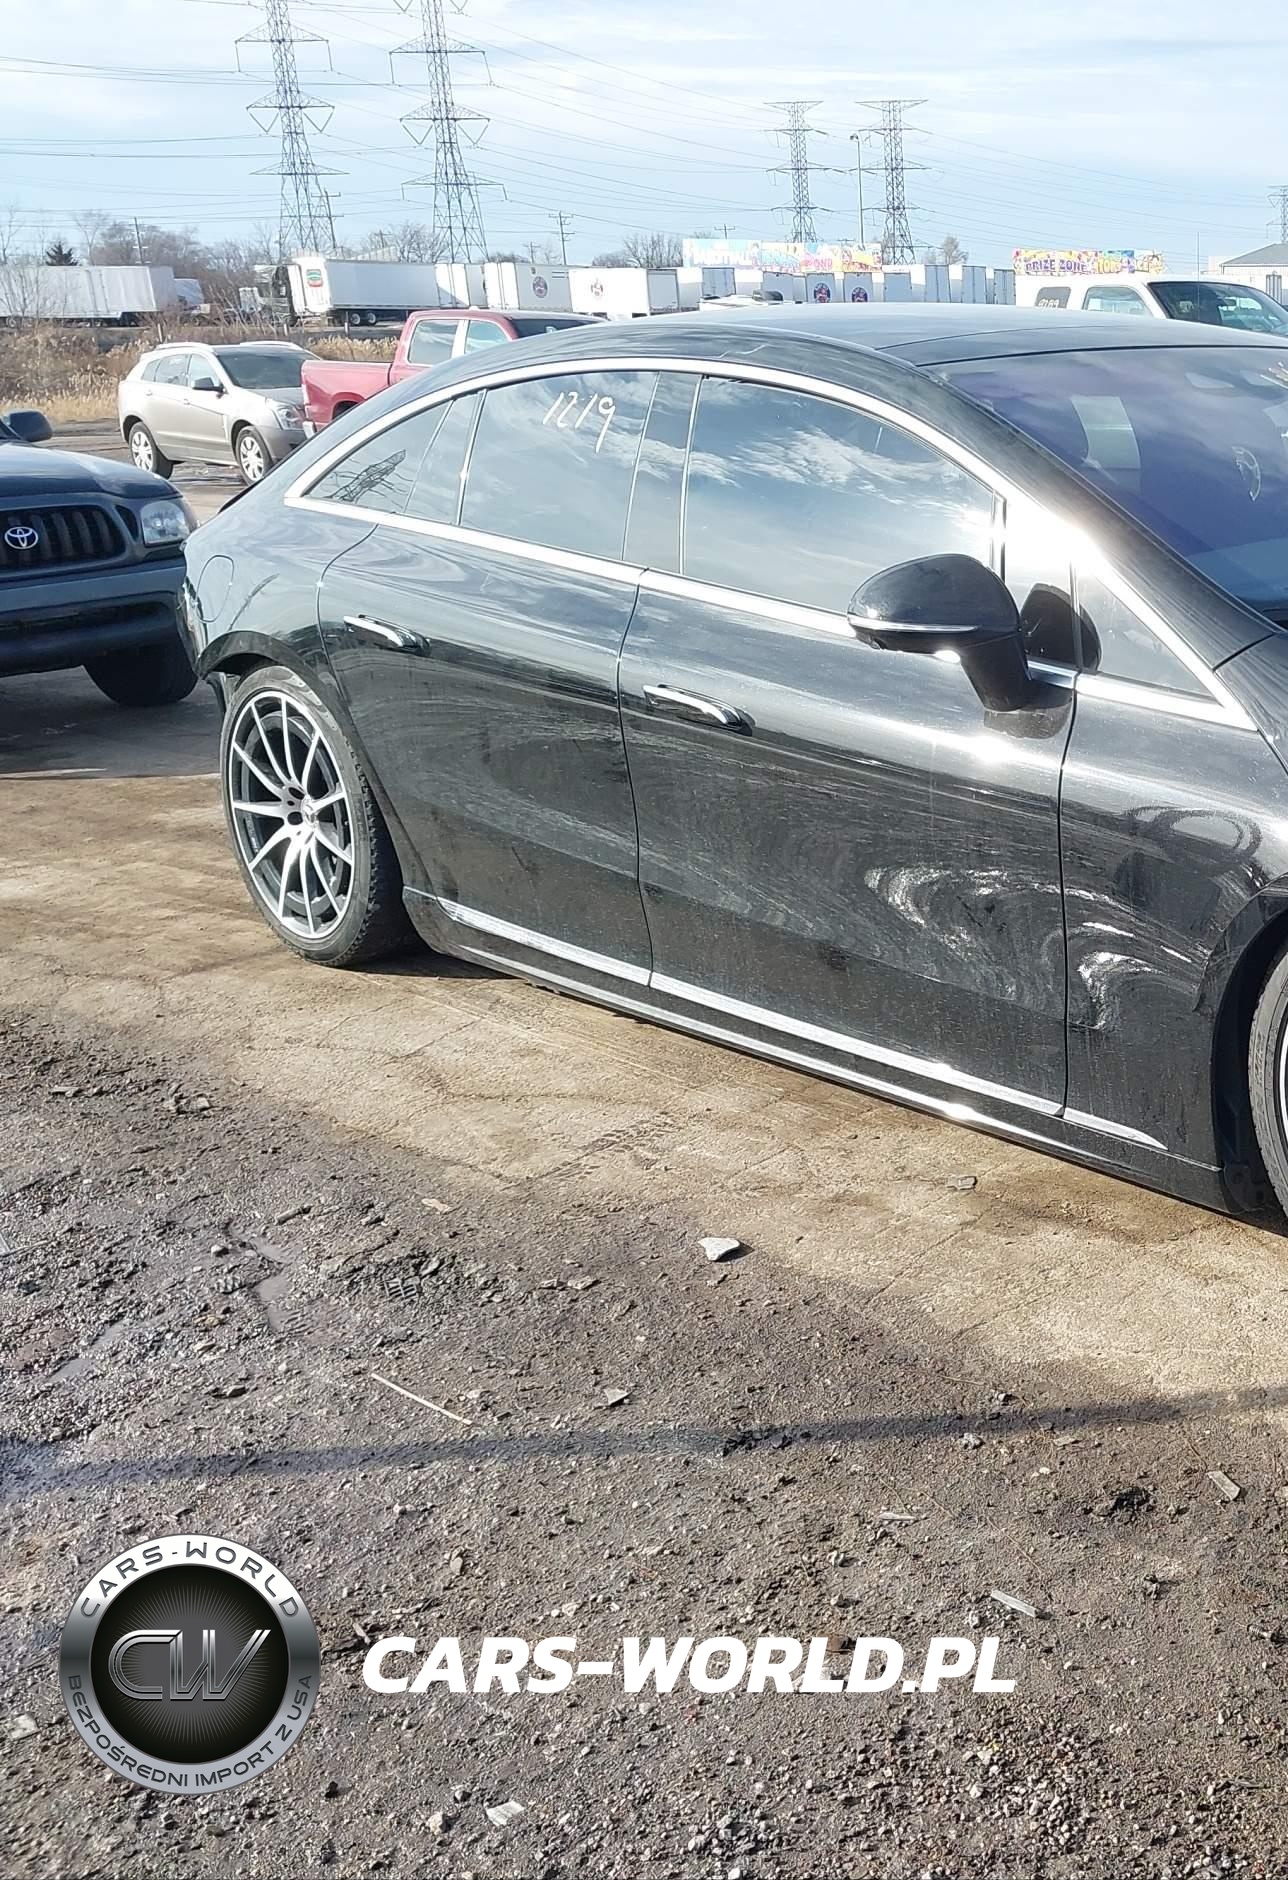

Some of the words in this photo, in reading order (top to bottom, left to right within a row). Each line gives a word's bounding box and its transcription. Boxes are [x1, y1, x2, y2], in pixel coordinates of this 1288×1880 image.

[1026, 258, 1056, 272] PRIZE
[1058, 258, 1087, 273] ZONE
[542, 391, 616, 453] 1219
